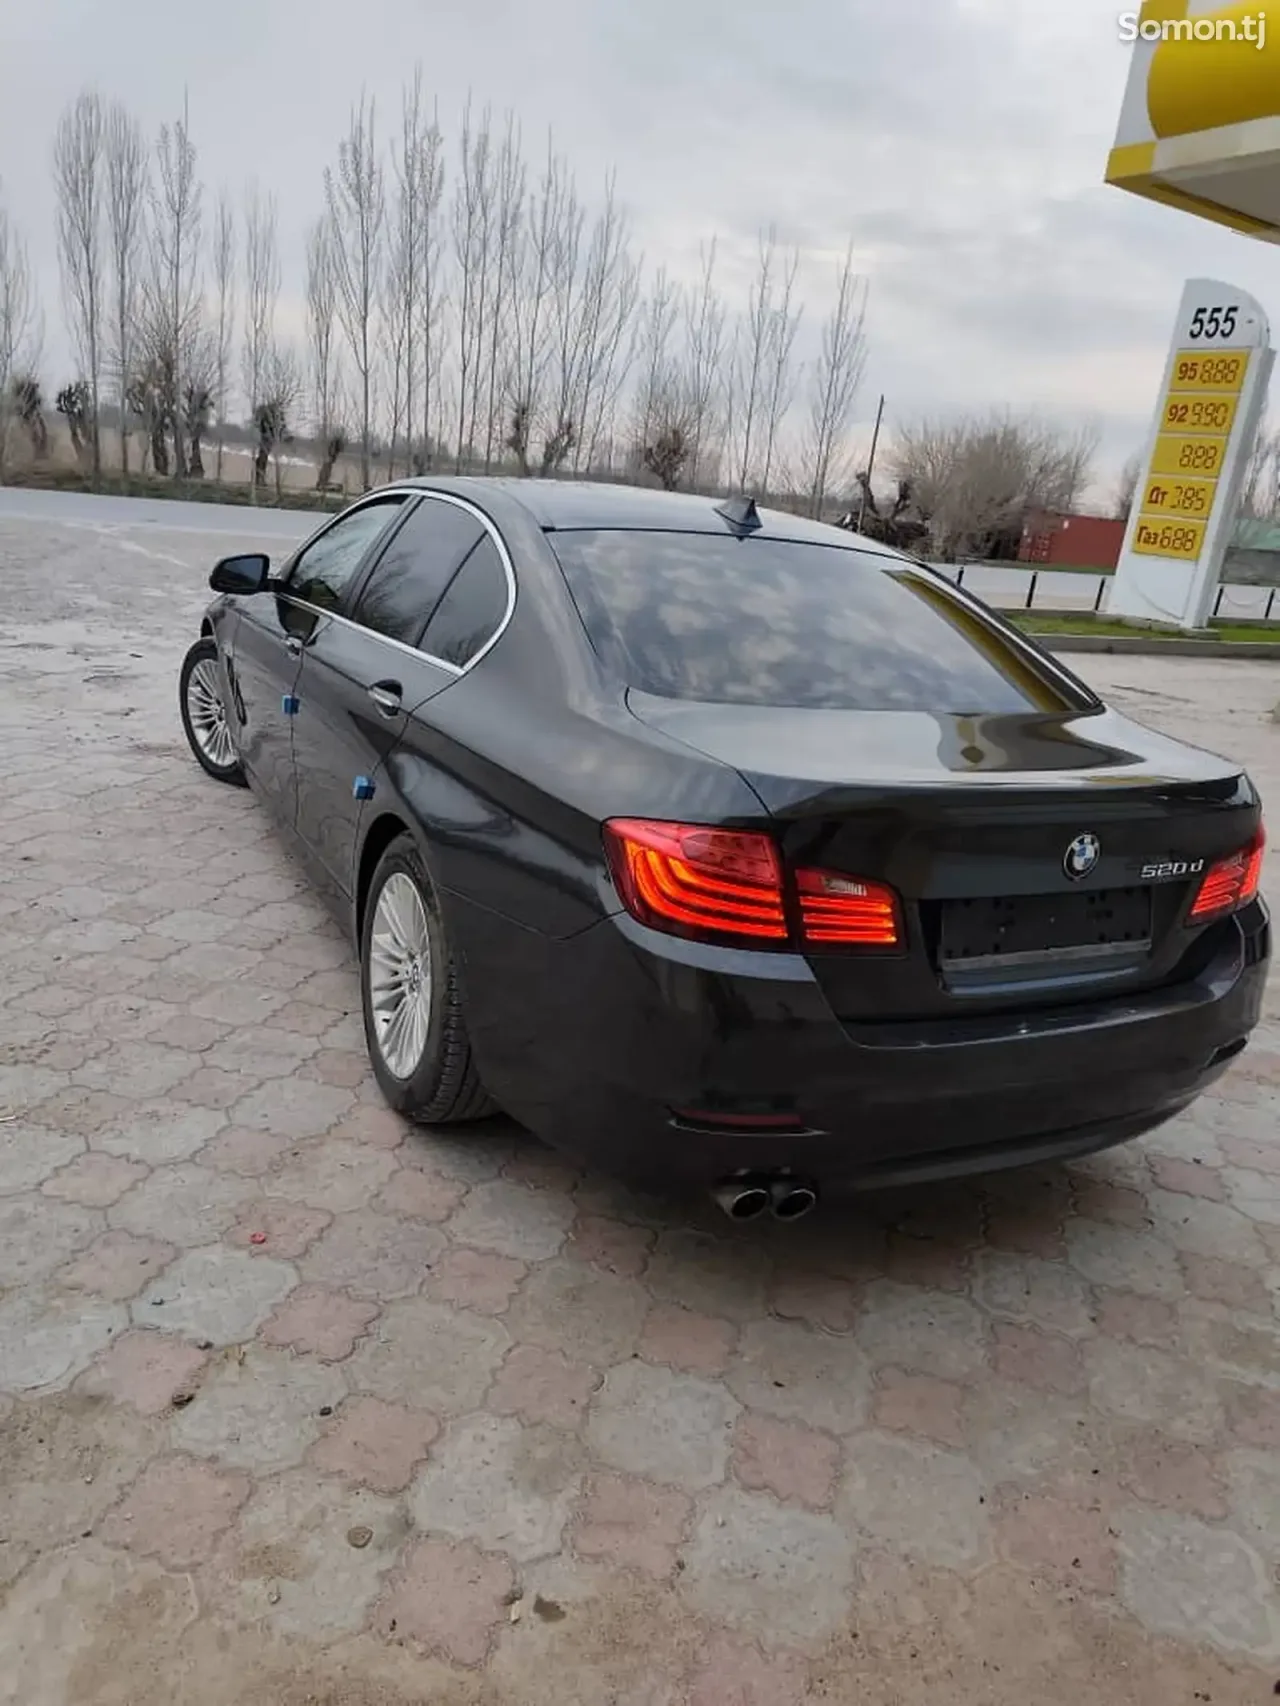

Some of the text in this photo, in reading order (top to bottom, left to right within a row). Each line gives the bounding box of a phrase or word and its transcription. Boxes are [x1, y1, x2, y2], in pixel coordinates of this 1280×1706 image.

[1189, 306, 1239, 339] 555
[1178, 362, 1199, 381] 95
[1167, 403, 1189, 423] 92
